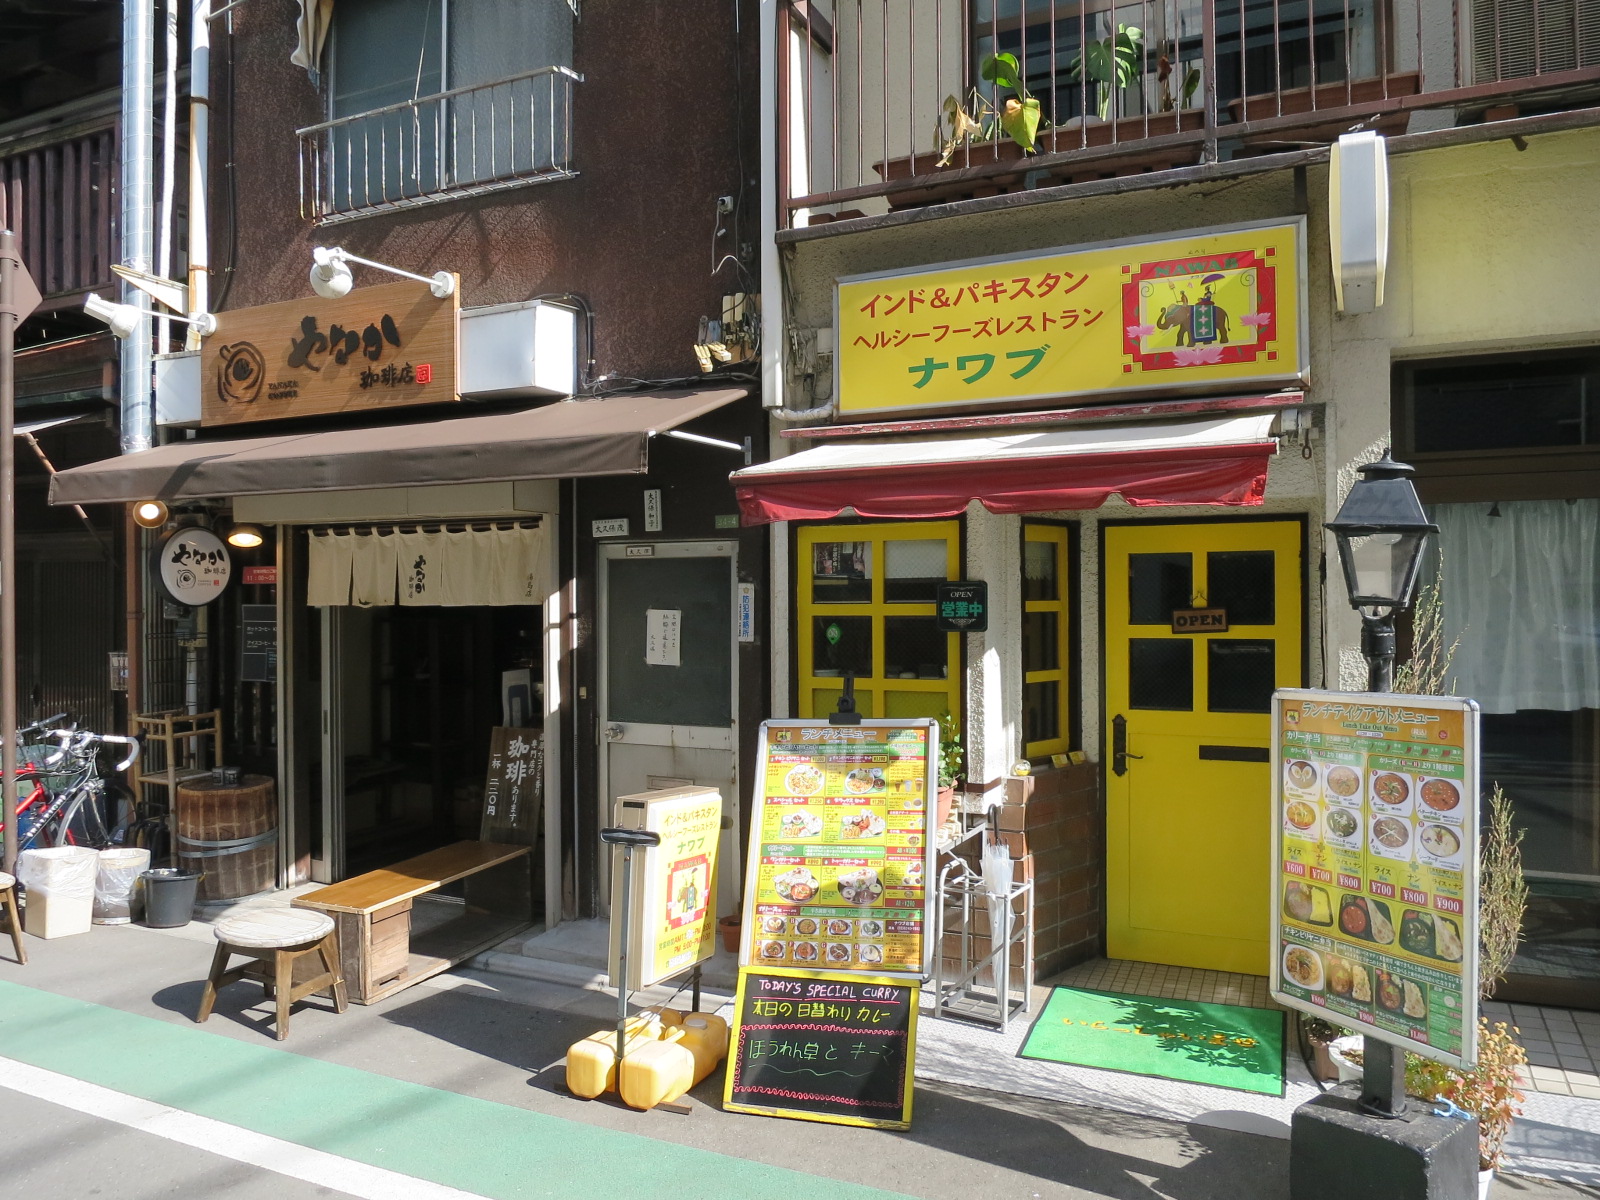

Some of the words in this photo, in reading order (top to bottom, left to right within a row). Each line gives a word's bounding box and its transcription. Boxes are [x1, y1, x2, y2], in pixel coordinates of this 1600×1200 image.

[1154, 257, 1239, 277] NAWAB
[860, 271, 1090, 318] インド&パキスタン
[853, 308, 1104, 351] ヘルシーフーズレストラン
[287, 313, 401, 372] やなか
[908, 344, 1052, 389] ナワブ
[359, 362, 414, 390] 珈琲店
[171, 543, 225, 566] やなか
[413, 554, 427, 594] やなか
[742, 595, 750, 637] 防犯連絡所
[941, 601, 983, 617] 営業中
[1176, 614, 1223, 627] OPEN
[1302, 702, 1439, 723] ランチテイクアウトメニュー
[801, 728, 877, 740] ランチメニュー
[1286, 731, 1321, 743] カリー弁当
[492, 753, 501, 769] 一杯
[662, 821, 718, 840] ヘルシーフーズレストラン
[677, 837, 706, 855] ナワブ
[1287, 847, 1302, 855] ライス
[1316, 853, 1327, 861] ナン
[1286, 862, 1303, 875] ¥600
[1312, 868, 1330, 881] ¥700
[1374, 866, 1391, 875] ライス
[1339, 875, 1358, 888] ¥800
[1408, 874, 1420, 882] ナン
[1371, 882, 1392, 896] ¥700
[1403, 890, 1425, 904] ¥800
[1436, 897, 1460, 912] ¥900
[806, 984, 857, 998] SPECIAL
[753, 999, 793, 1017] 本日の
[798, 1002, 852, 1021] 日替わり
[856, 1006, 892, 1023] カレー
[748, 1039, 820, 1061] ほうれん草
[825, 1045, 838, 1060] と
